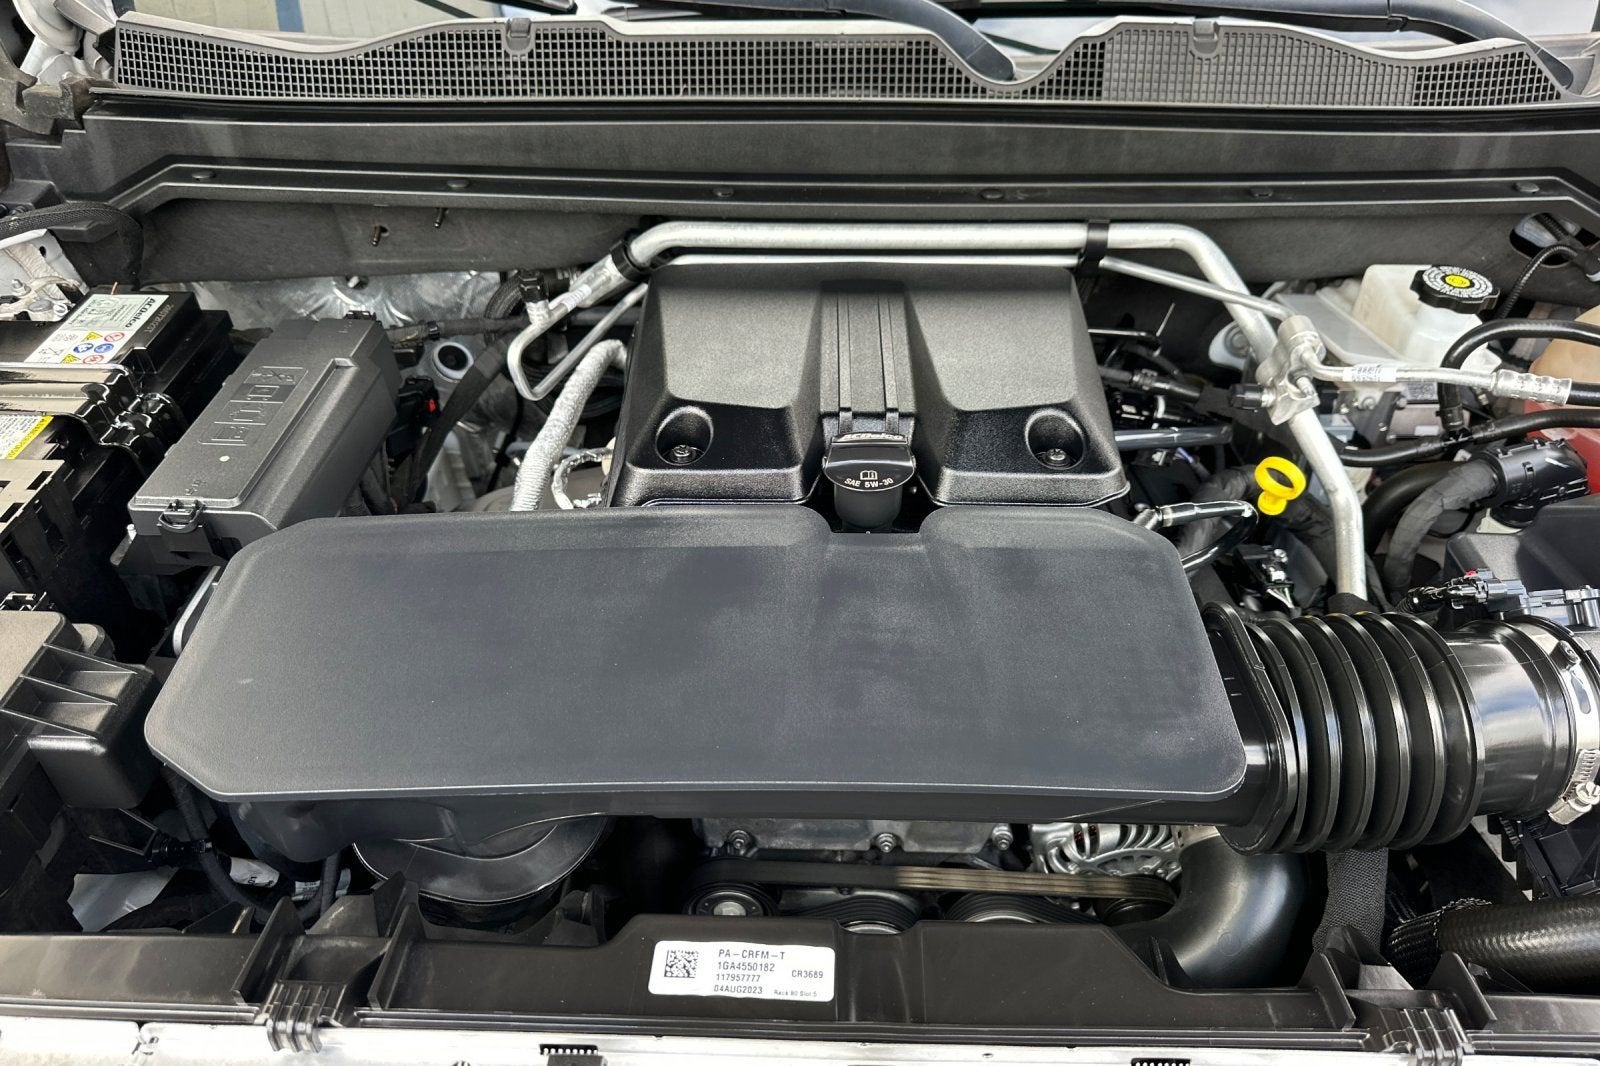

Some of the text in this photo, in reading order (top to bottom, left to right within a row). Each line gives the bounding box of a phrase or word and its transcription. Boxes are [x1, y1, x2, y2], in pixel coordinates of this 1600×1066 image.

[125, 298, 156, 328] ACDelco
[844, 477, 894, 488] SAE 5W-30
[718, 961, 775, 972] 1GA4550182
[716, 973, 761, 982] 117957777
[791, 969, 824, 979] CR3689
[713, 984, 763, 994] 04AUG2023
